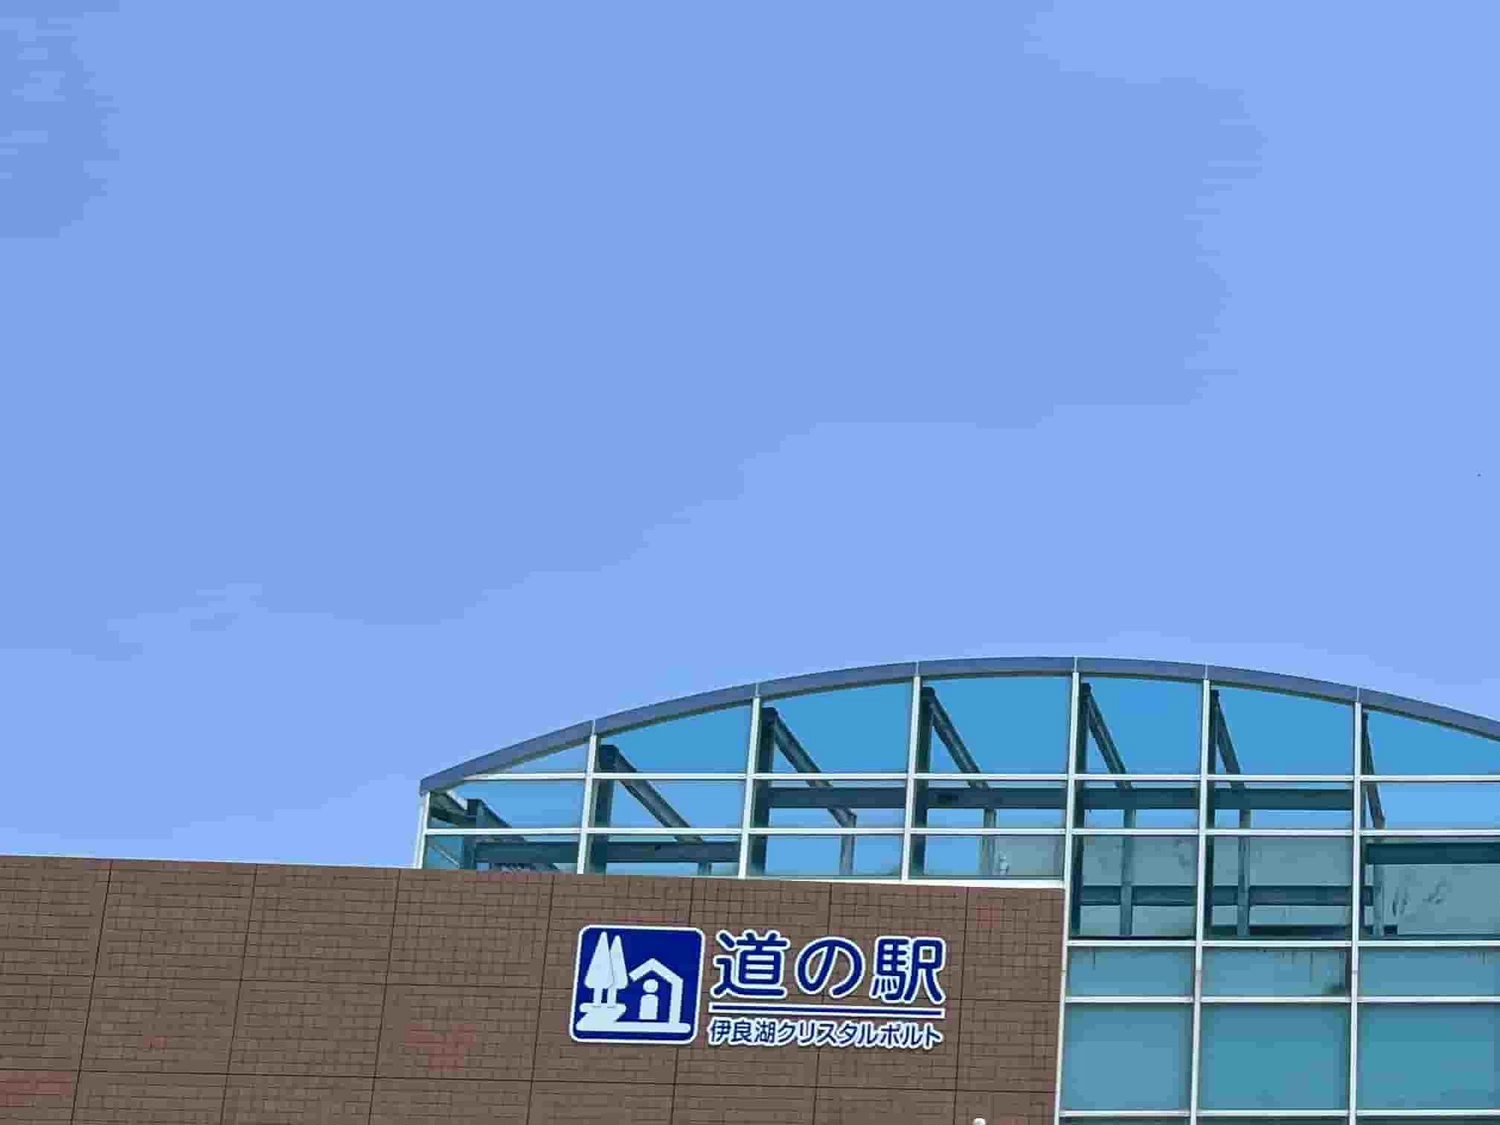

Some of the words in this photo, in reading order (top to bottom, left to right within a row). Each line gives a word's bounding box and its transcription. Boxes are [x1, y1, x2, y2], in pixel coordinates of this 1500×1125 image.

[712, 932, 945, 1003] 道の駅
[709, 1018, 942, 1048] 伊良湖クリスタルポルト
